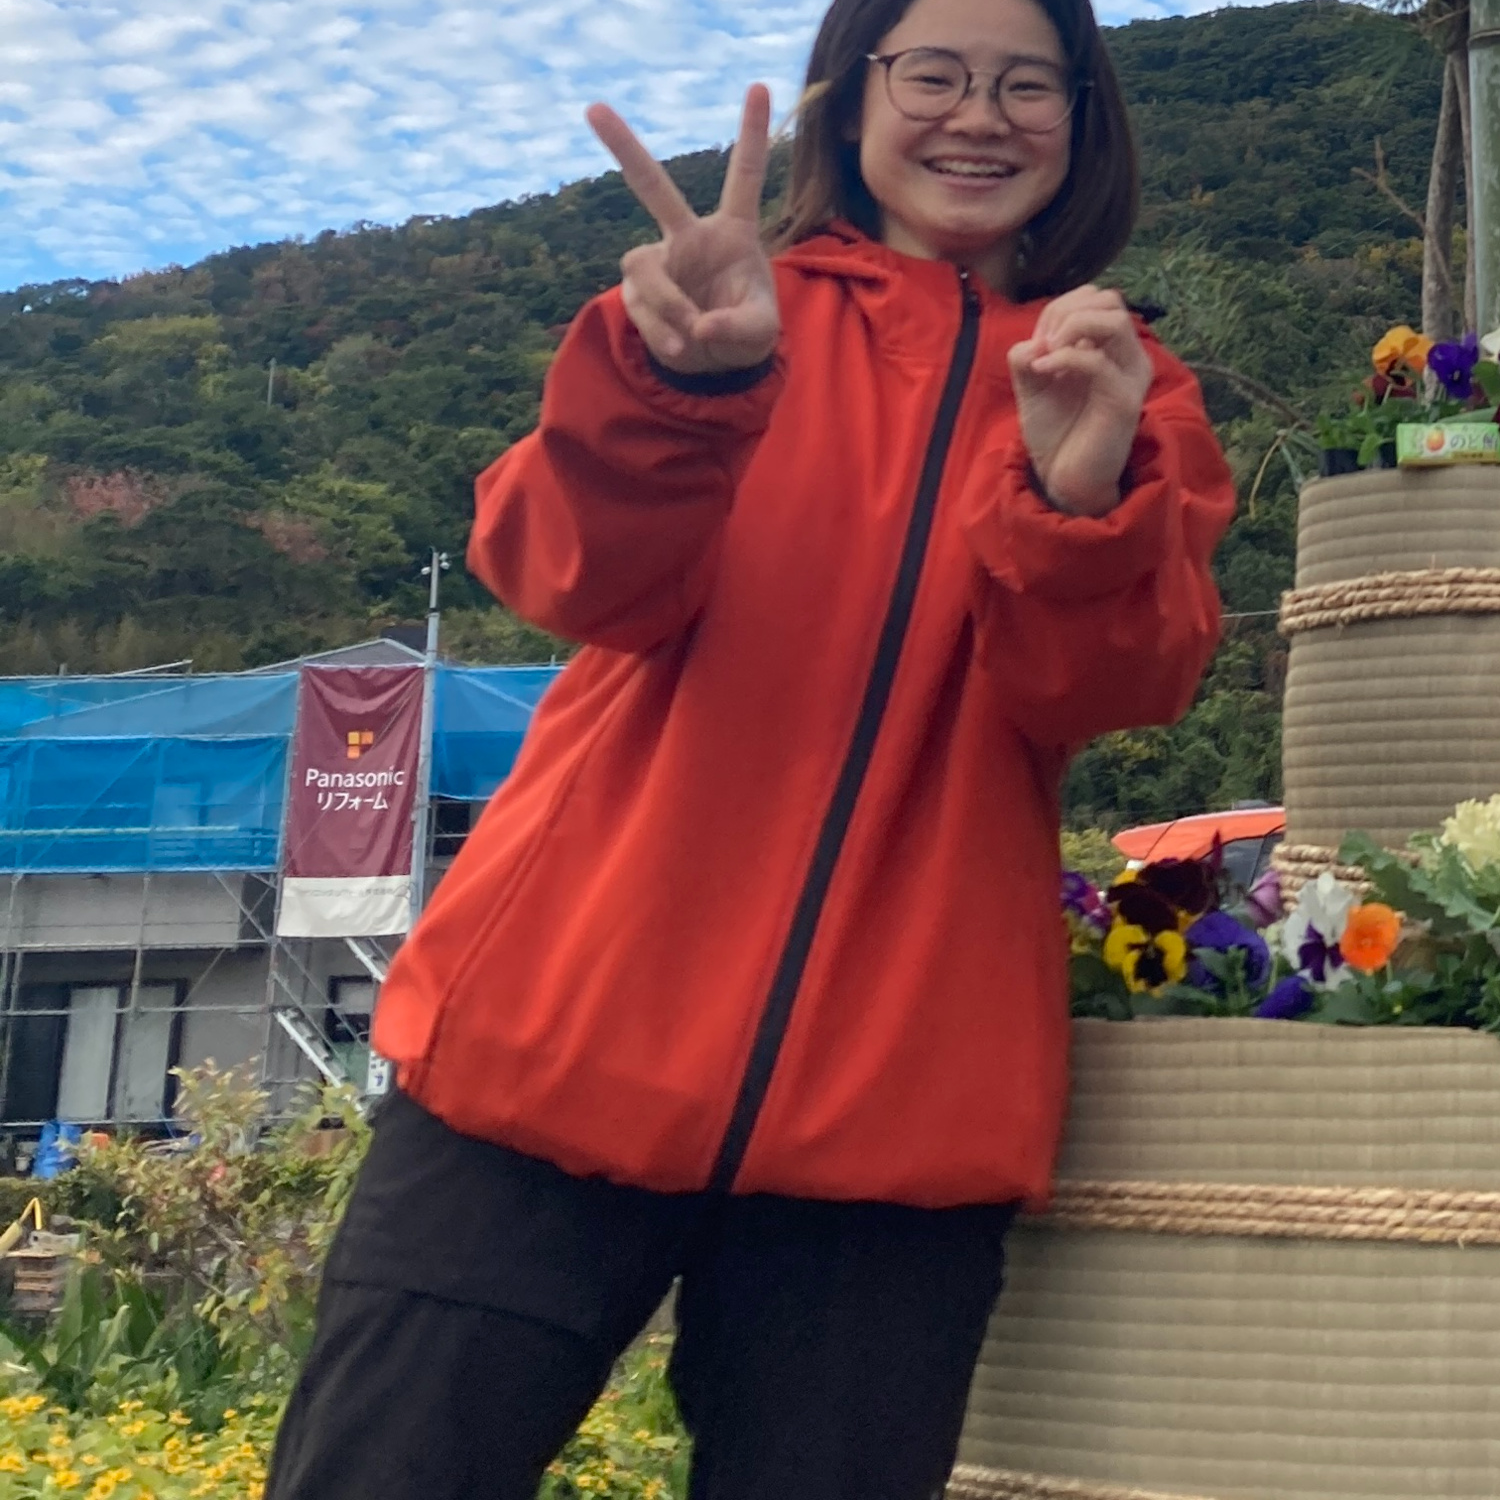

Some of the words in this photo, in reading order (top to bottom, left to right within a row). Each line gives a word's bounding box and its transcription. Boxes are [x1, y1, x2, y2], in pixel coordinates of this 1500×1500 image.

[305, 765, 405, 788] Panasonic
[317, 791, 389, 812] リフォーム
